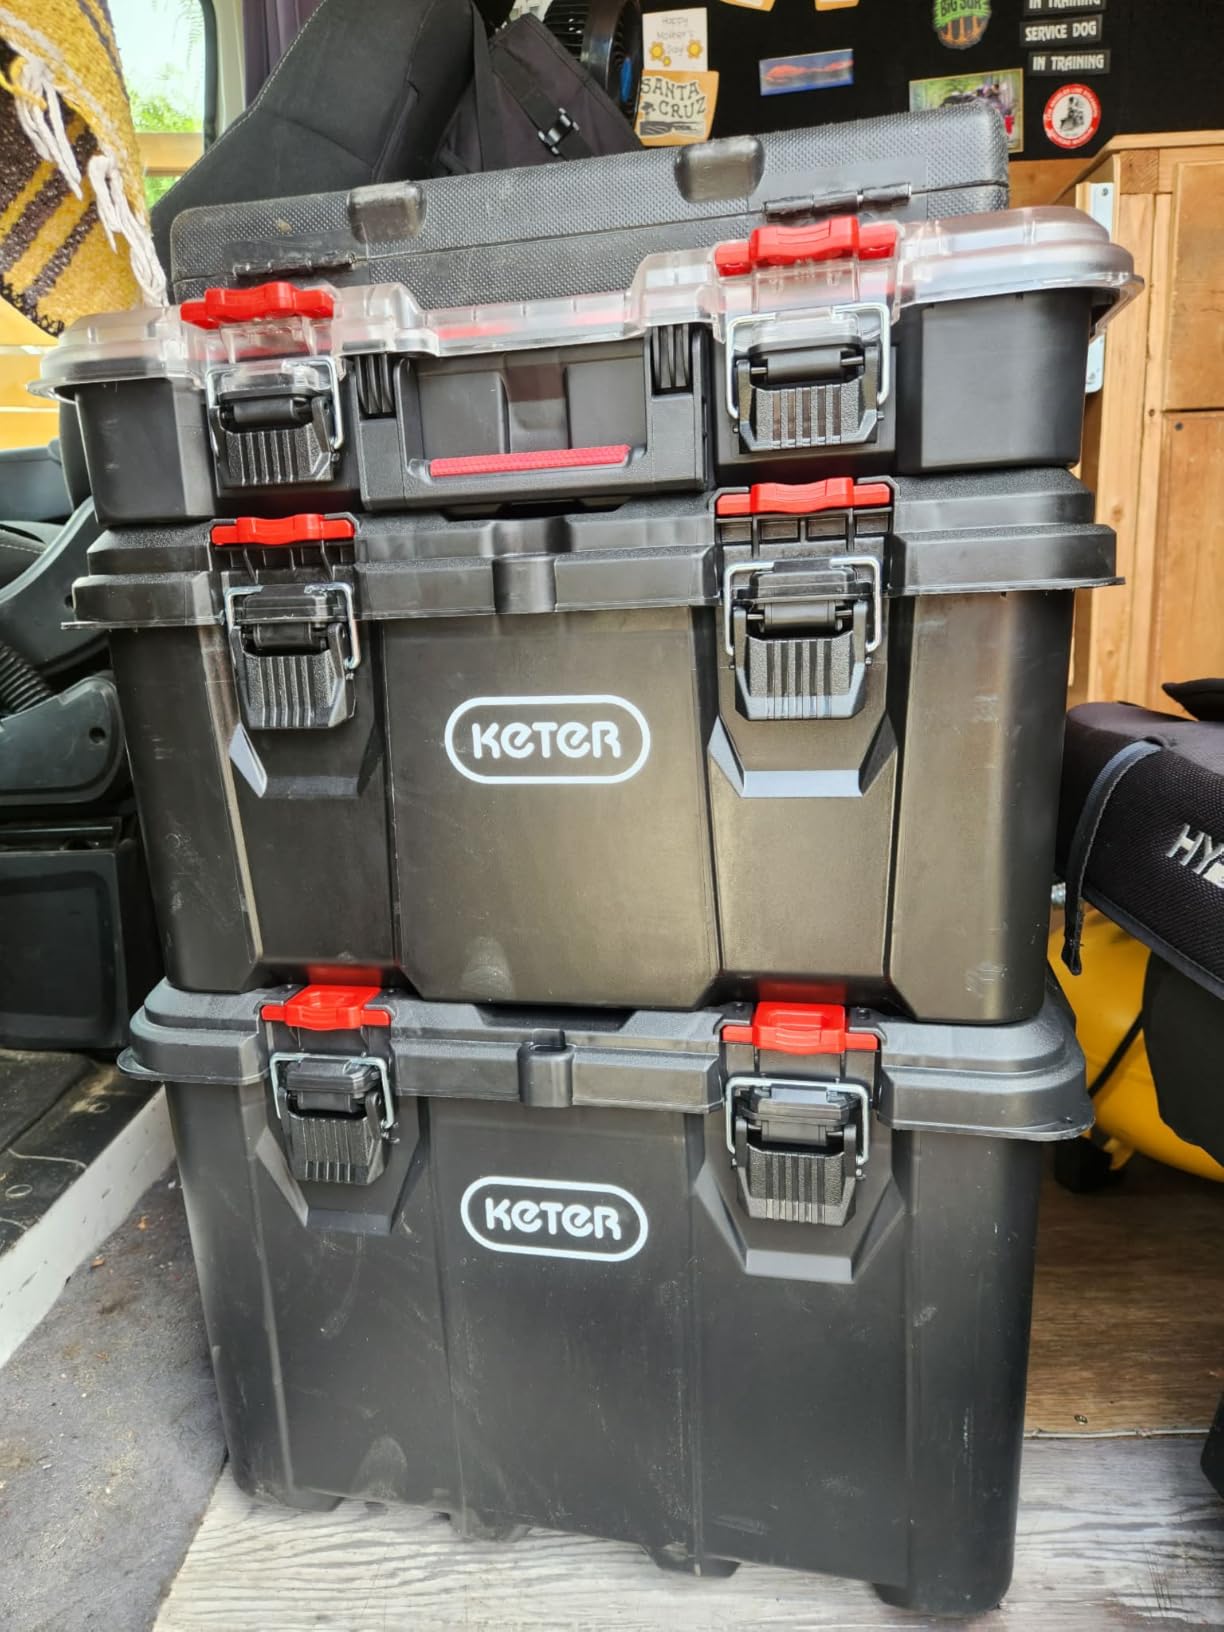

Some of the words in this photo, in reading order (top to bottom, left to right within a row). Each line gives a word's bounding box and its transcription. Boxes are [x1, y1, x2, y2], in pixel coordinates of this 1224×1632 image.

[1025, 24, 1068, 41] SERVICE
[1072, 21, 1097, 37] DOG
[1032, 56, 1046, 71] IN
[1051, 54, 1105, 71] TRAINING
[640, 78, 700, 101] SANTA
[658, 95, 706, 118] CRUZ
[471, 721, 622, 759] KETER
[485, 1197, 622, 1241] KETER
